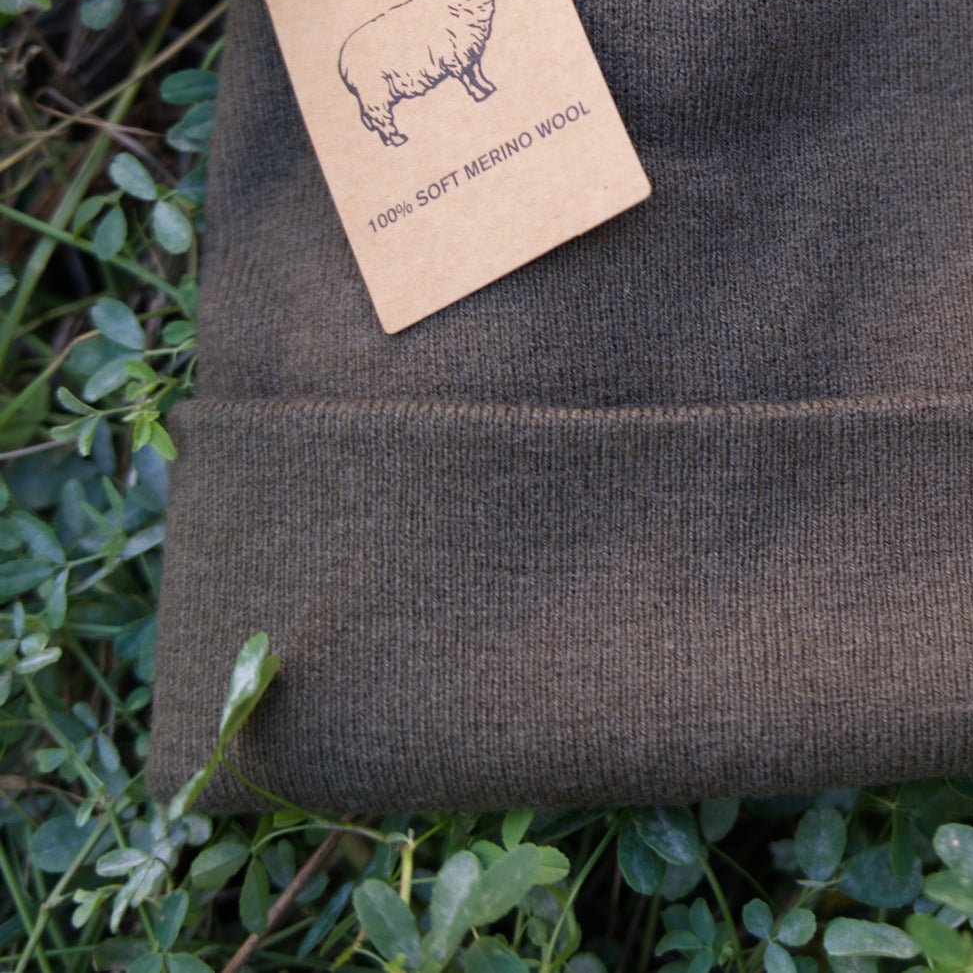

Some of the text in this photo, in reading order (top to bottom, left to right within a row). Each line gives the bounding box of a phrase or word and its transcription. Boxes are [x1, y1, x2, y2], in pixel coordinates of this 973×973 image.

[368, 100, 591, 233] 100% SOFT MERINO WOOL
